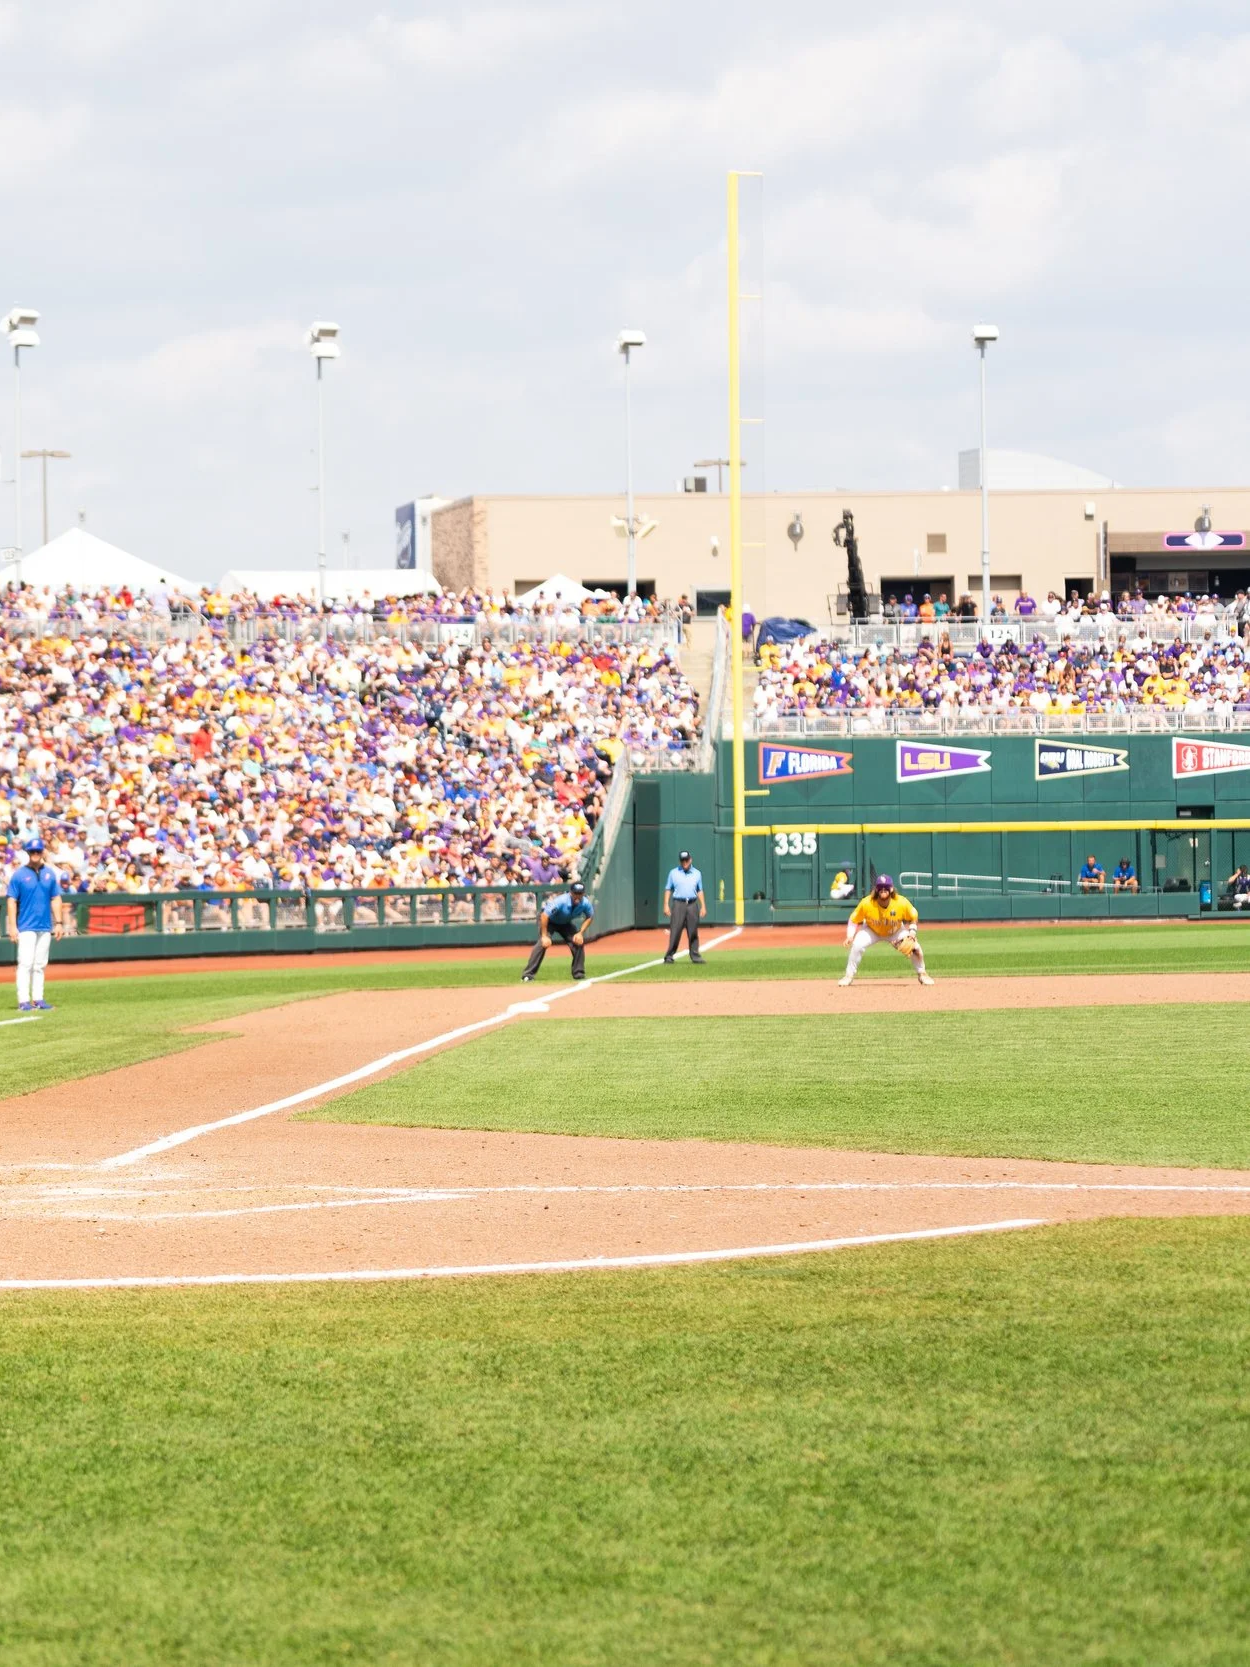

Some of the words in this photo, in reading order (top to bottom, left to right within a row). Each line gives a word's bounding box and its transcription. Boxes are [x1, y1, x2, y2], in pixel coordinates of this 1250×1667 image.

[788, 752, 838, 774] FLORIDA
[904, 752, 951, 771] LSU
[774, 833, 818, 856] 335
